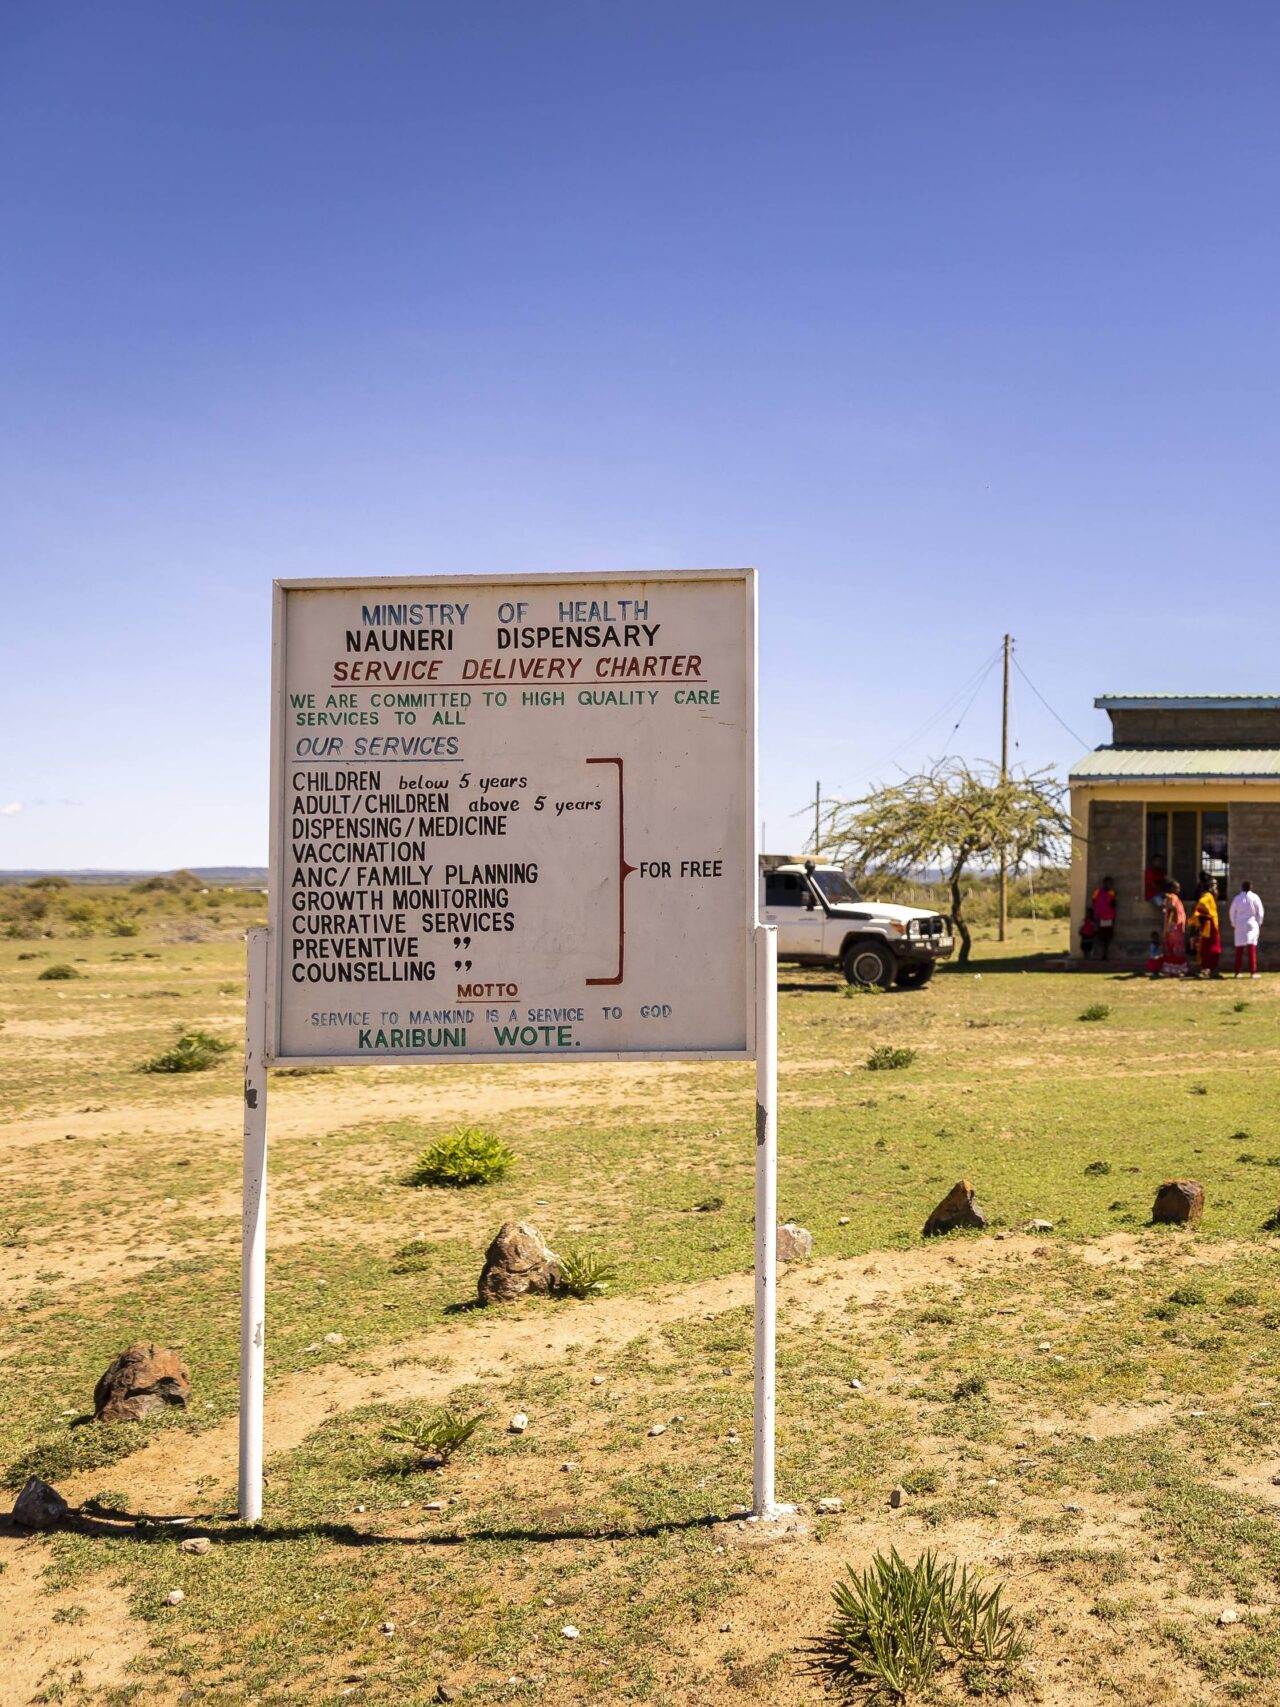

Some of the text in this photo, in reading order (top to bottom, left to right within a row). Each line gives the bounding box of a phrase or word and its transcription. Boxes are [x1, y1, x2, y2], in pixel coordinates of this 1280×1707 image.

[361, 599, 649, 626] MINISTRY OF HEALTH
[345, 623, 661, 653] NAUNERI DISPENSARY
[333, 654, 702, 682] SERVICE DELIVERY CHARTER
[289, 689, 721, 709] WE ARE COMMITTED TO HIGH QUALITY CARE
[295, 710, 466, 727] SERVICES TO ALL
[295, 736, 459, 757] OUR SERVICES
[292, 770, 528, 794] CHILDREN below 5 years
[292, 792, 602, 817] ADULT/CHILDREN above 5 years
[292, 815, 508, 840] DISPENSING/MEDICINE
[291, 840, 426, 864] VACCINATION
[445, 862, 539, 886] PLANNING
[639, 859, 723, 879] FOR FREE
[291, 887, 509, 912] GROWTH MONITORING
[291, 911, 515, 935] CURRATIVE SERVICES
[292, 936, 419, 960] PREVENTIVE
[291, 960, 436, 984] COUNSELLING
[456, 982, 519, 998] MOTTO
[310, 1004, 673, 1027] SERVICE TO MANKIND IS A SERVICE TO GOD
[358, 1025, 581, 1049] KARIBUNI WOTE.
